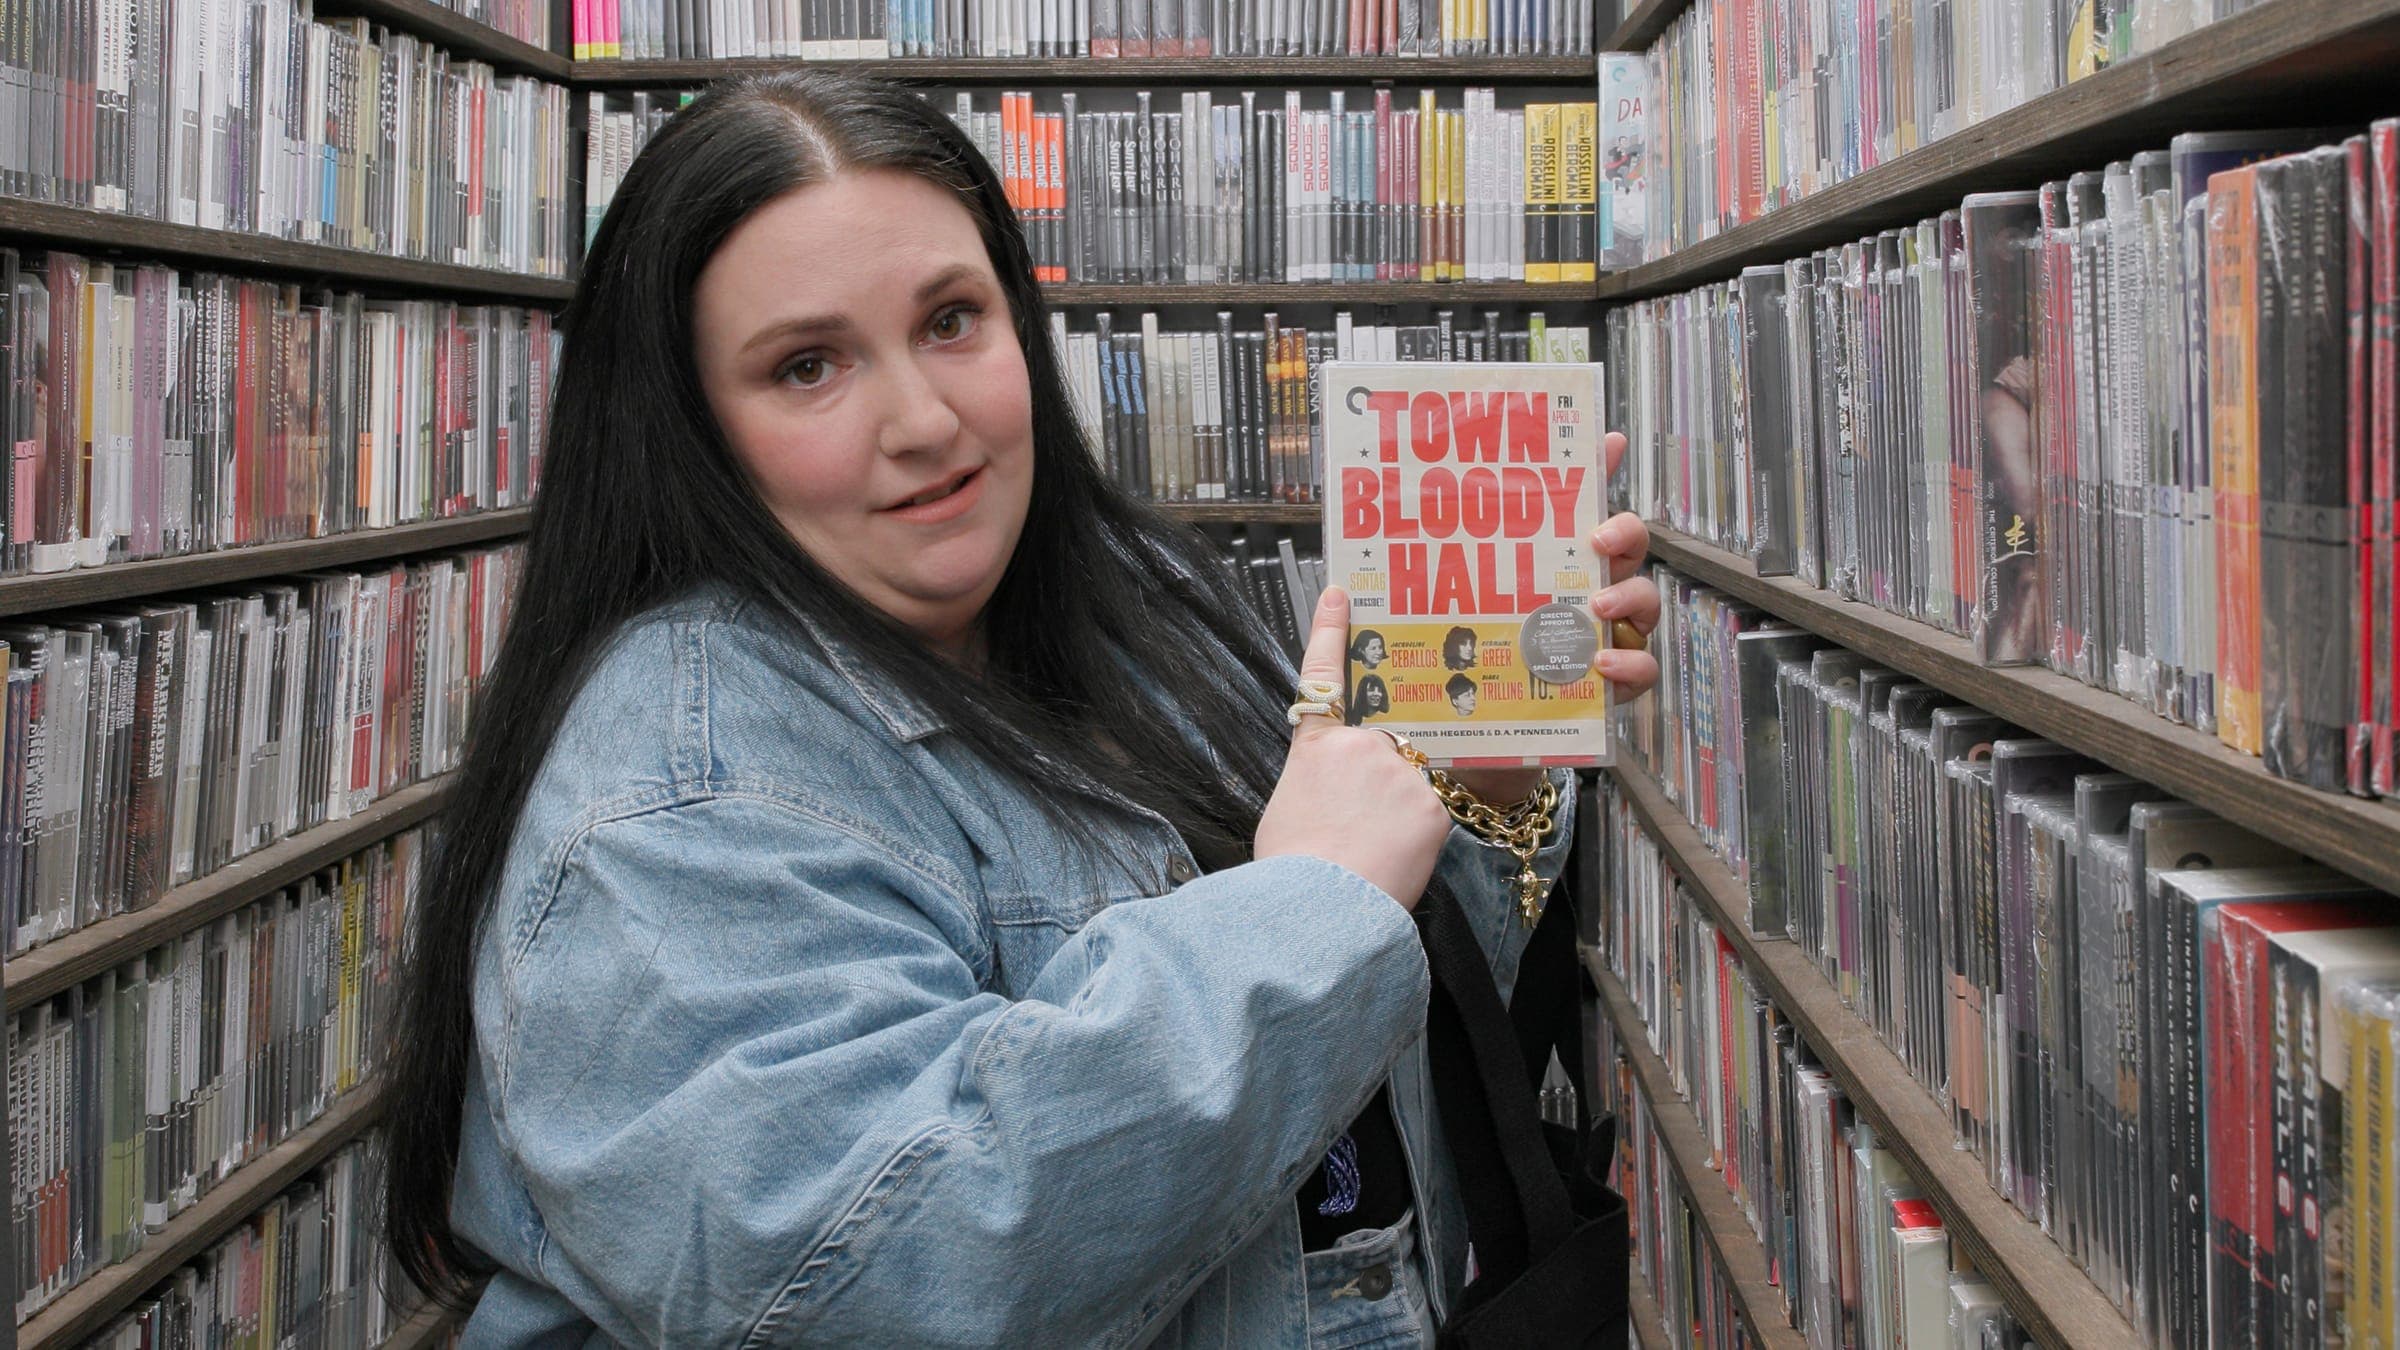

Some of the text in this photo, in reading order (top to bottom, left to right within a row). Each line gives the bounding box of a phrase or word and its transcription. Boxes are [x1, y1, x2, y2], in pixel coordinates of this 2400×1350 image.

[603, 126, 614, 178] BADLANDS
[1289, 105, 1298, 173] SECONDS
[1303, 124, 1313, 192] SECONDS
[1319, 124, 1328, 191] SECONDS
[1530, 144, 1542, 200] BERGMAN
[1544, 138, 1556, 199] ROSSELLINI
[1566, 144, 1578, 199] BERGMAN
[1579, 137, 1591, 199] ROSSELLINI
[2096, 245, 2105, 317] HIGH
[1308, 346, 1320, 413] PERSONA
[1557, 396, 1573, 409] FRI
[2131, 360, 2140, 443] SHRINKING
[1367, 391, 1548, 463] TOWN
[1552, 410, 1570, 424] APRIL
[1558, 426, 1574, 438] 1971
[2133, 449, 2141, 482] MAN
[1341, 467, 1586, 539] BLOODY
[1350, 573, 1386, 591] SONTAG
[1388, 543, 1552, 616] HALL
[1391, 650, 1438, 668] CEBALLOS
[1482, 650, 1512, 667] GREER
[151, 663, 161, 737] CONFIDENTIAL
[154, 629, 174, 777] MR. ARKADIN
[1392, 684, 1443, 703] JOHNSTON
[1482, 682, 1524, 701] TRILLING
[26, 723, 39, 774] SLEEP
[1408, 729, 1438, 738] CHRIS
[1514, 728, 1580, 738] PENNEBAKER
[24, 783, 38, 828] WELL
[2185, 938, 2193, 1029] INFERNAL
[2187, 1036, 2195, 1114] AFFAIRS
[2369, 1048, 2381, 1098] THREE
[31, 1054, 39, 1185] BRUTE FORCE
[2370, 1103, 2381, 1154] FILMS
[2370, 1158, 2381, 1180] BY
